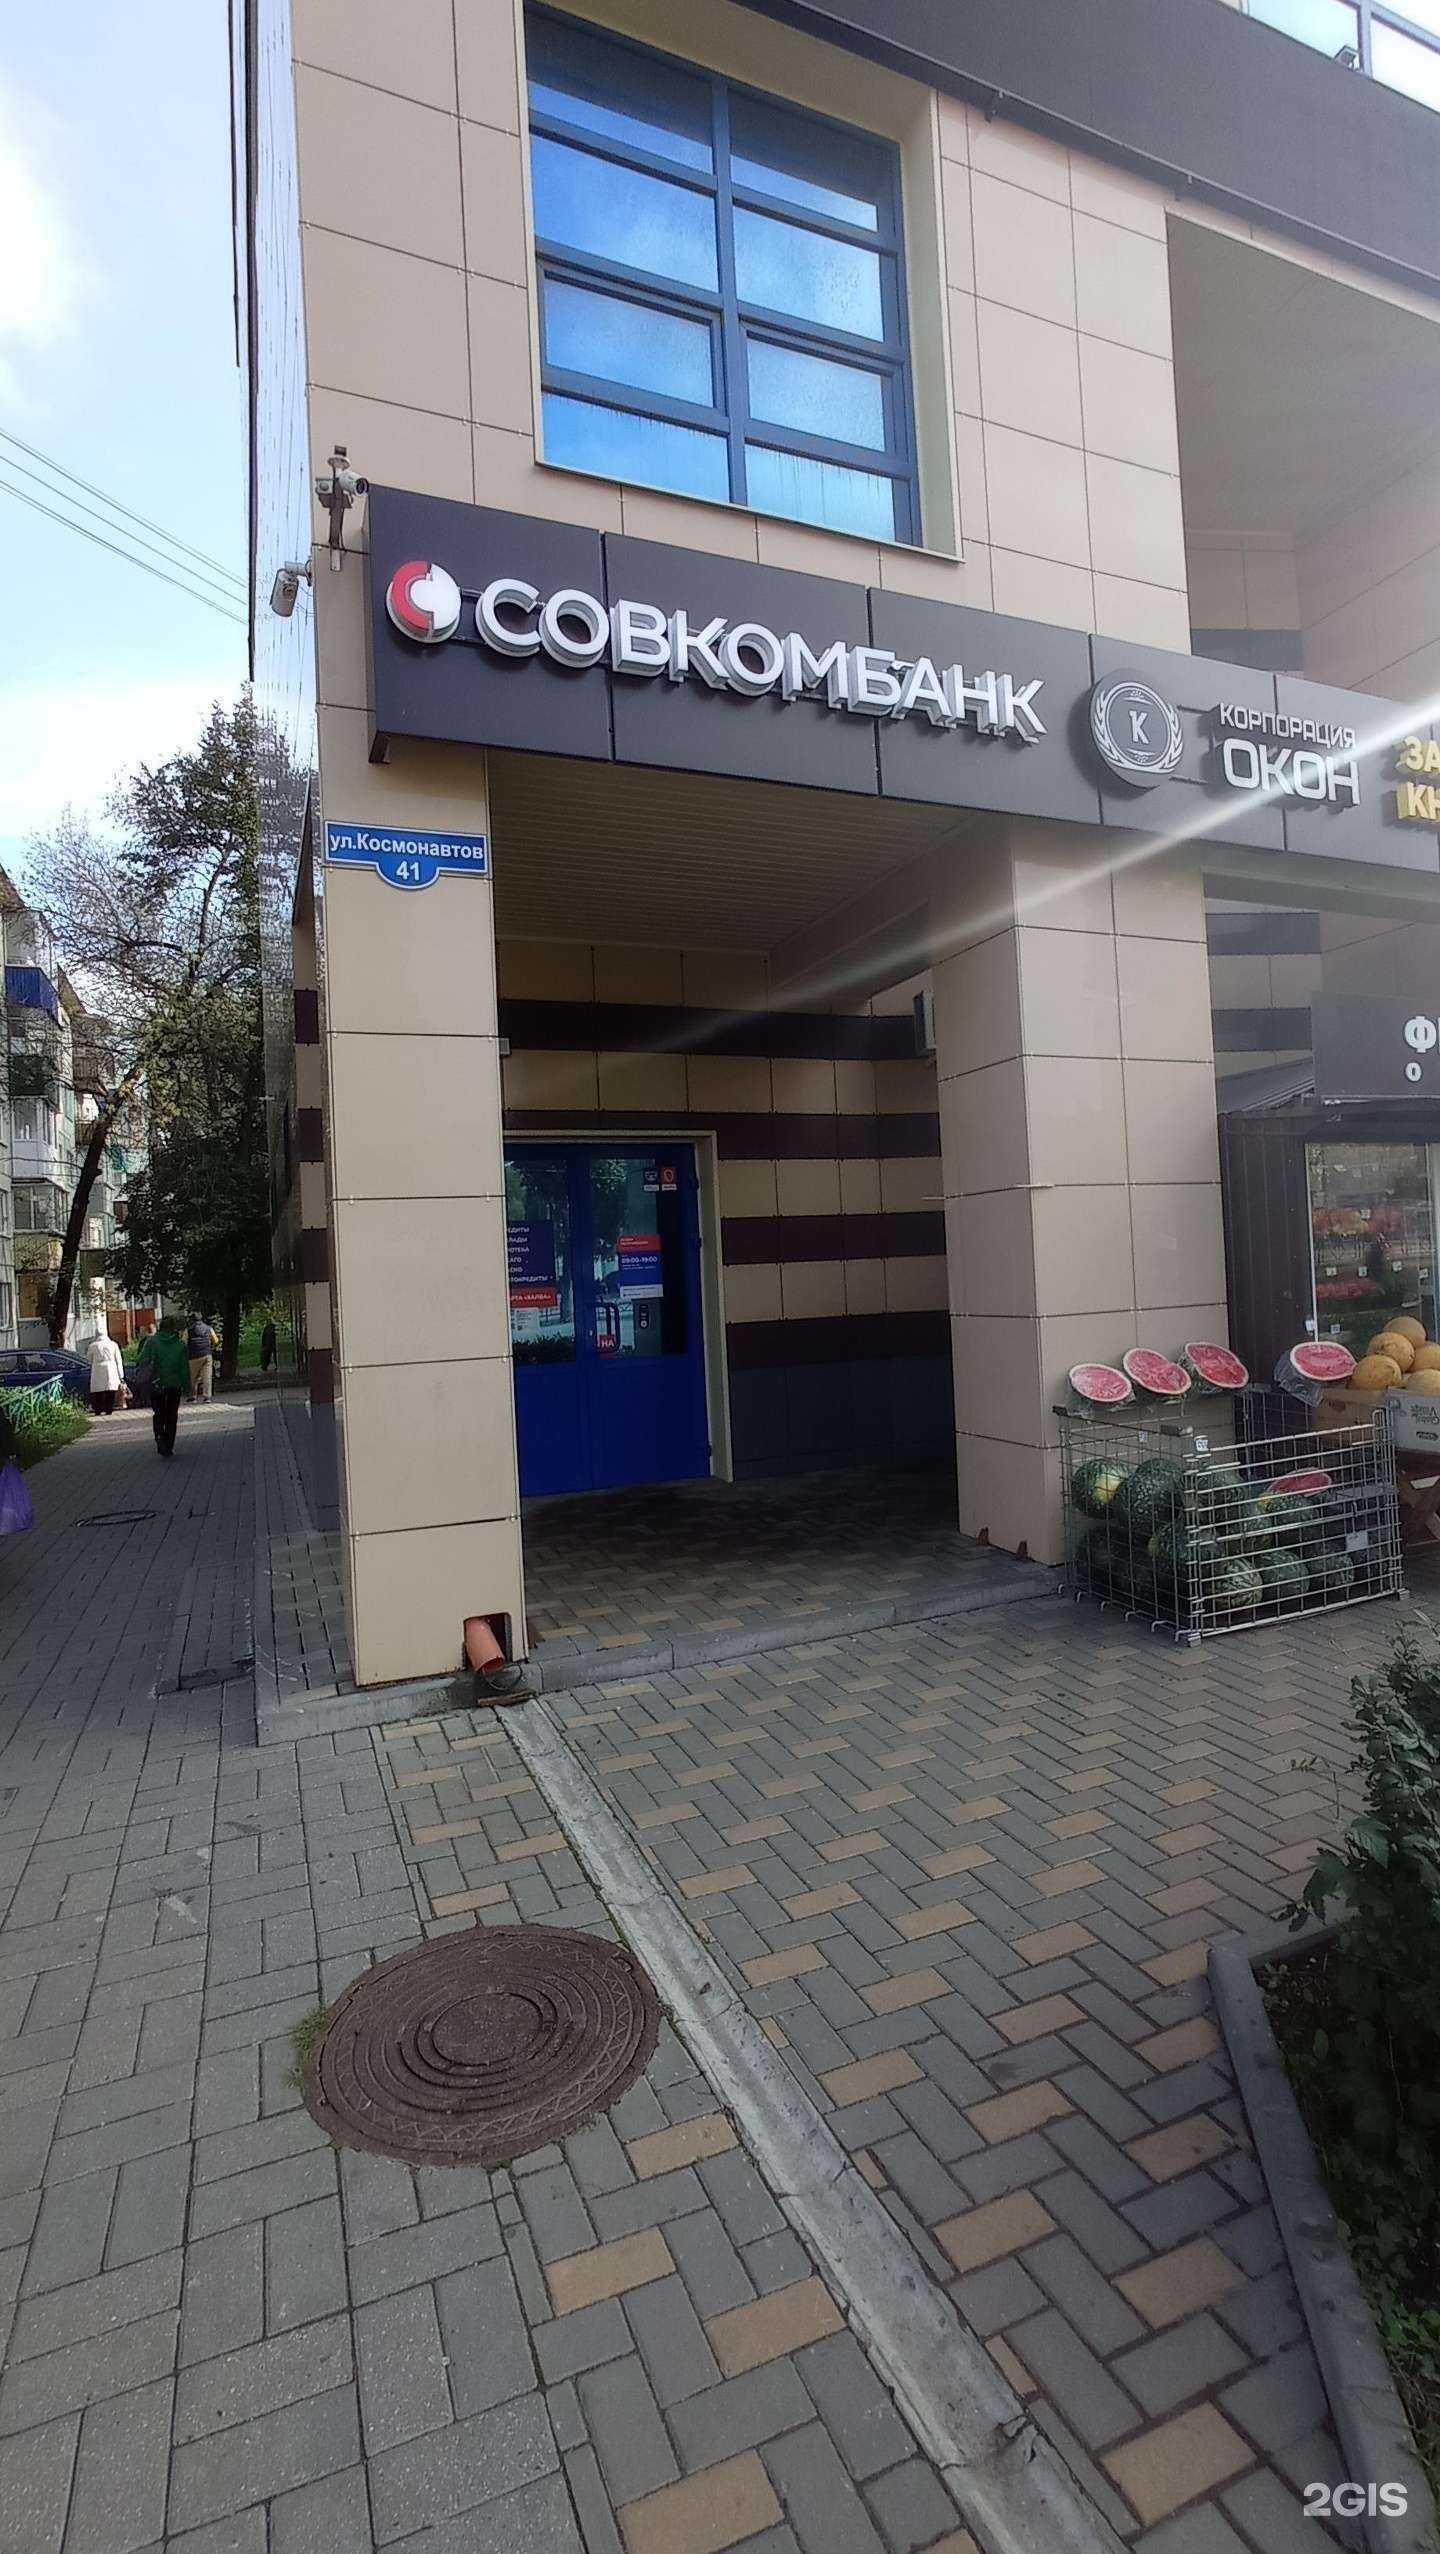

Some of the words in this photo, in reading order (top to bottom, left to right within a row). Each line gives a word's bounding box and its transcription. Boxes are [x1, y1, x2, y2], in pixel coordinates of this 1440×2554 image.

[475, 578, 1048, 742] СОВКОМБАНК
[1220, 703, 1357, 749] КОРПОРАЦИЯ
[1222, 738, 1361, 806] ОКОН
[330, 832, 484, 859] ул.Космонавтов
[396, 861, 420, 881] 41
